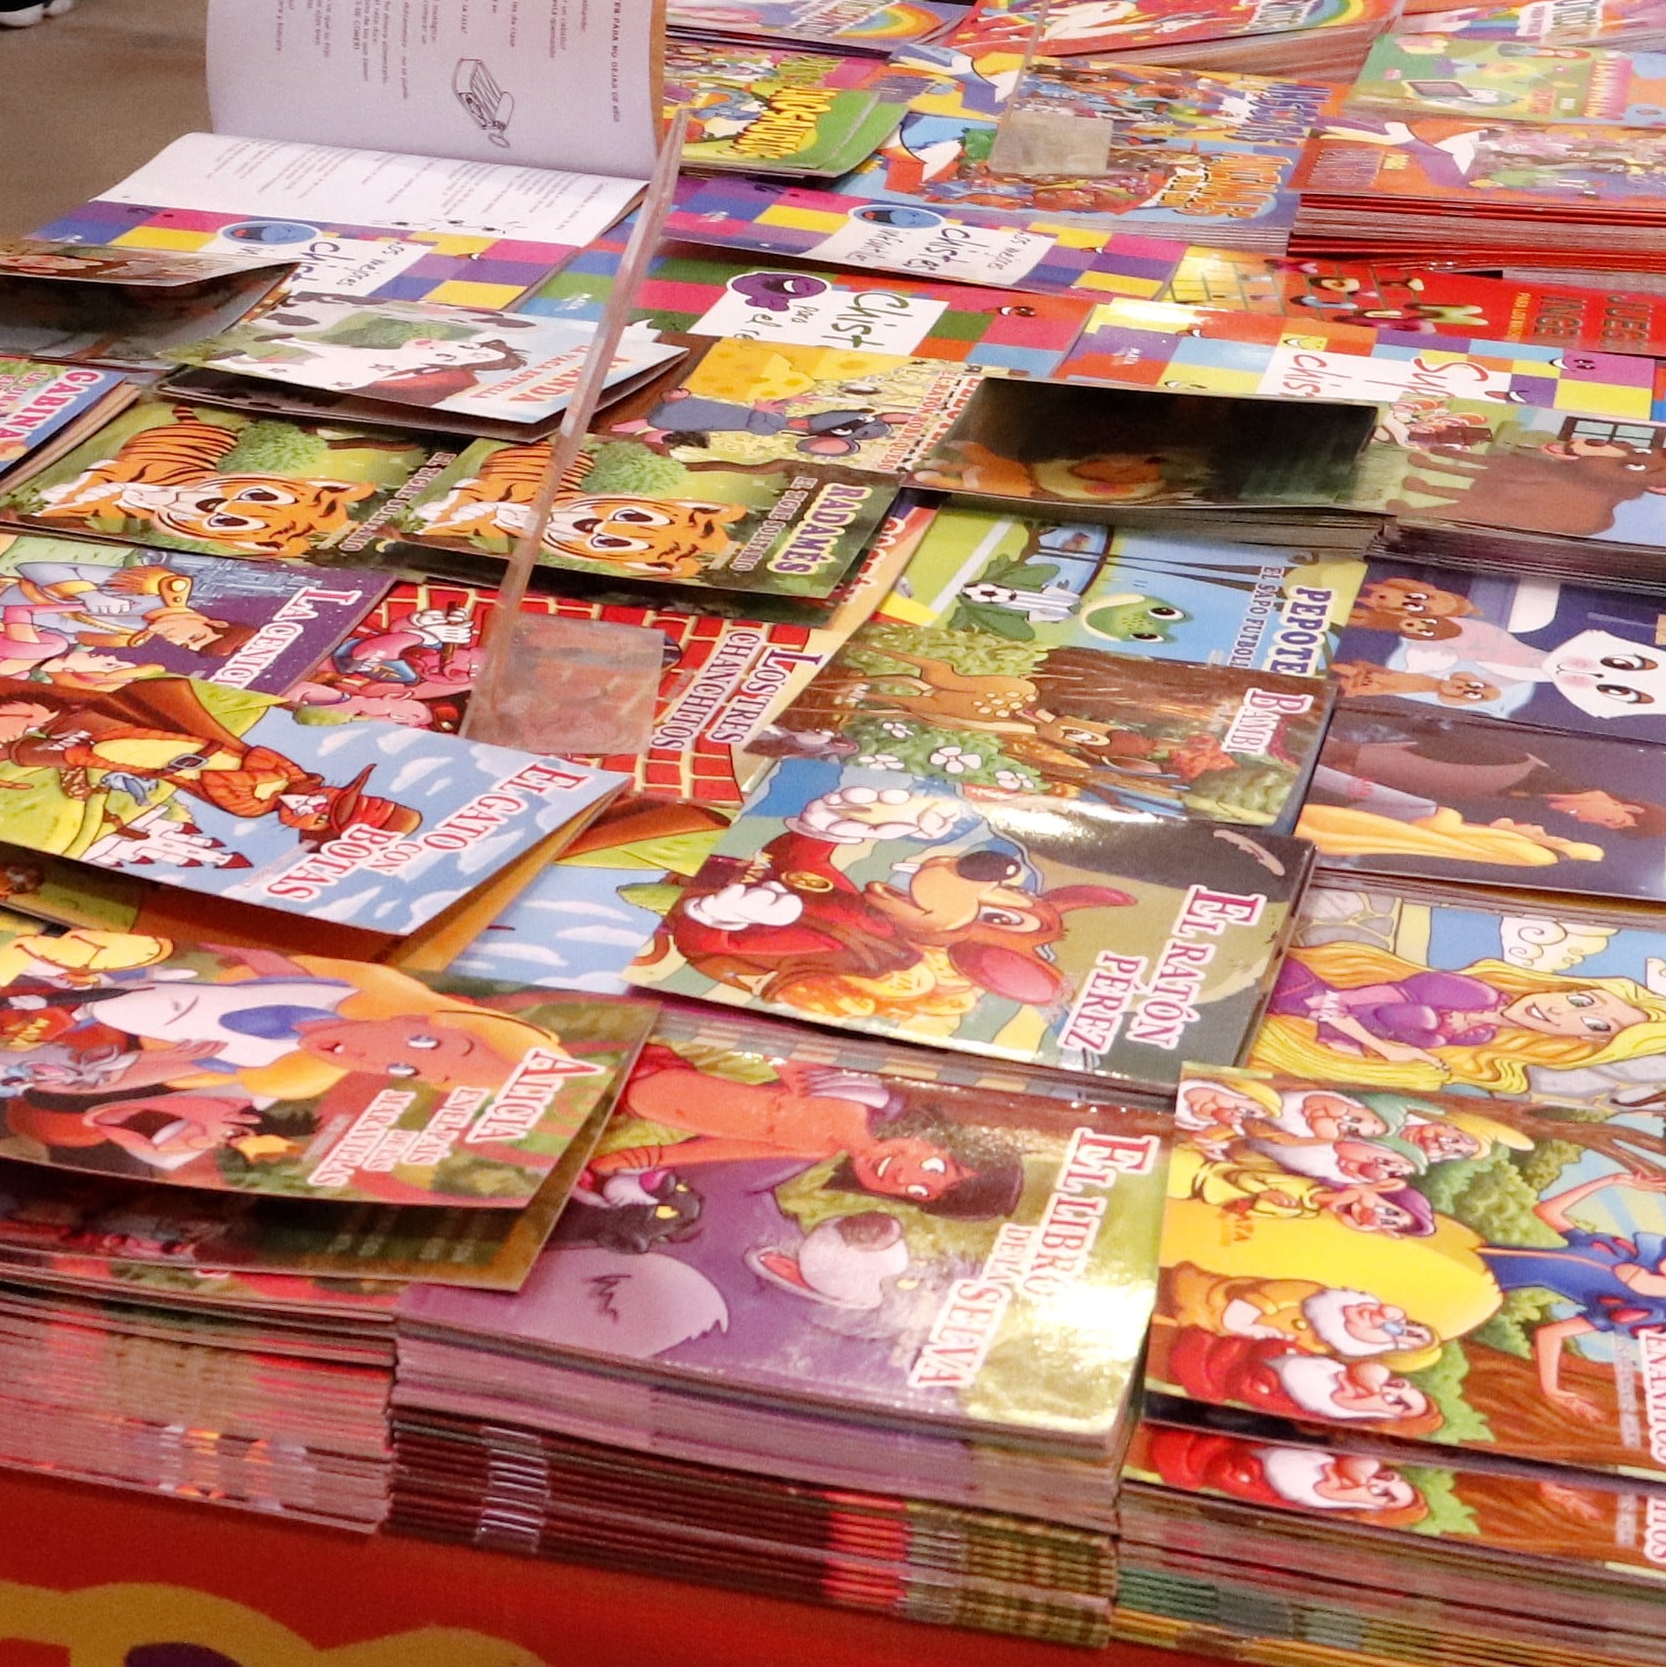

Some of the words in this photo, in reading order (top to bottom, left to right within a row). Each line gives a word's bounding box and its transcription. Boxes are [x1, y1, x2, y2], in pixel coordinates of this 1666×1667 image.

[770, 483, 860, 574] RADAMÉS
[1271, 587, 1332, 673] PEPOTE
[651, 631, 761, 751] CHANCHITOS
[741, 649, 824, 694] LOS
[706, 698, 770, 744] TRES
[1222, 690, 1313, 755] BAMBI
[419, 790, 531, 856] GATO
[517, 764, 587, 815] EL
[268, 825, 399, 899] BOTAS
[379, 840, 423, 876] CON
[1184, 890, 1263, 937] EL
[1062, 952, 1136, 1050] PÉREZ
[1129, 940, 1205, 1047] RATÓN
[472, 1051, 603, 1142] ALICIA
[310, 1090, 412, 1187] MARAVILLAS
[1073, 1133, 1156, 1196] EL
[911, 1281, 1009, 1386] SELVA
